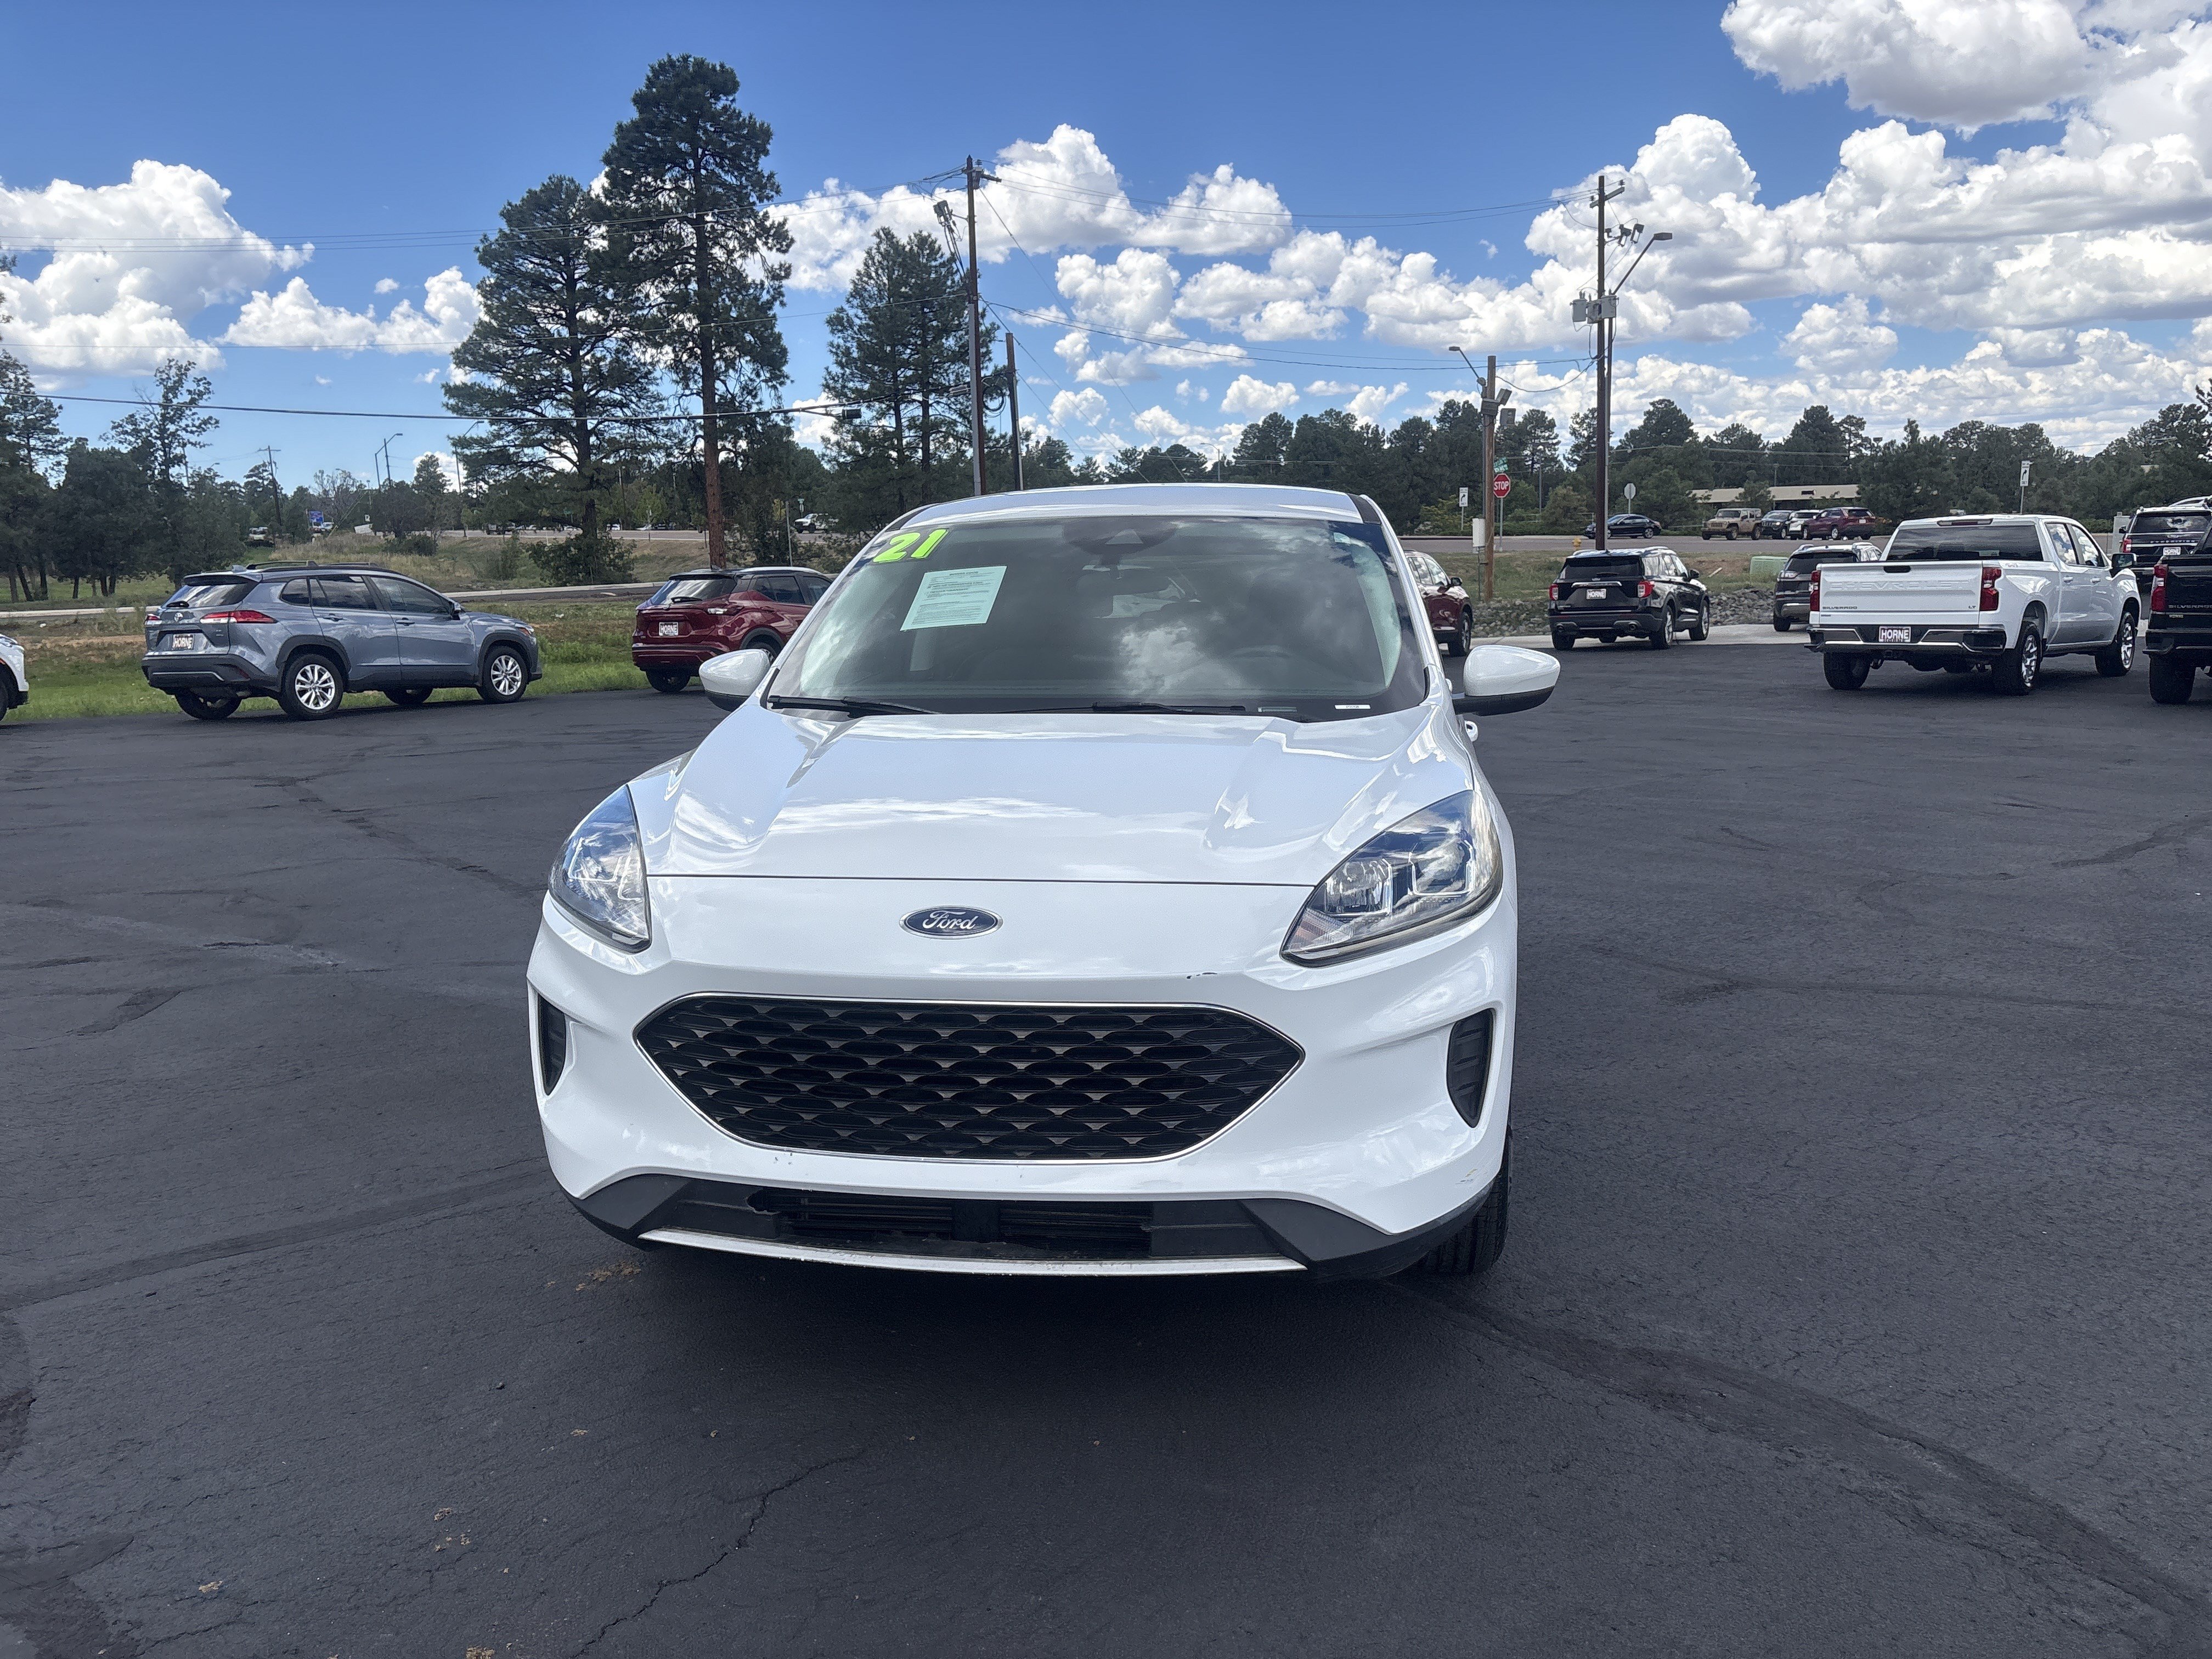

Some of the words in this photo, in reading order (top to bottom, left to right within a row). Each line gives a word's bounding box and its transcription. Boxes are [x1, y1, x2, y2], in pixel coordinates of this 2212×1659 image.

[1494, 481, 1509, 490] STOP
[873, 529, 948, 563] 21
[661, 625, 677, 634] HORNE
[1881, 629, 1909, 640] HORNE
[173, 637, 193, 647] HORNE
[923, 911, 978, 929] Ford
